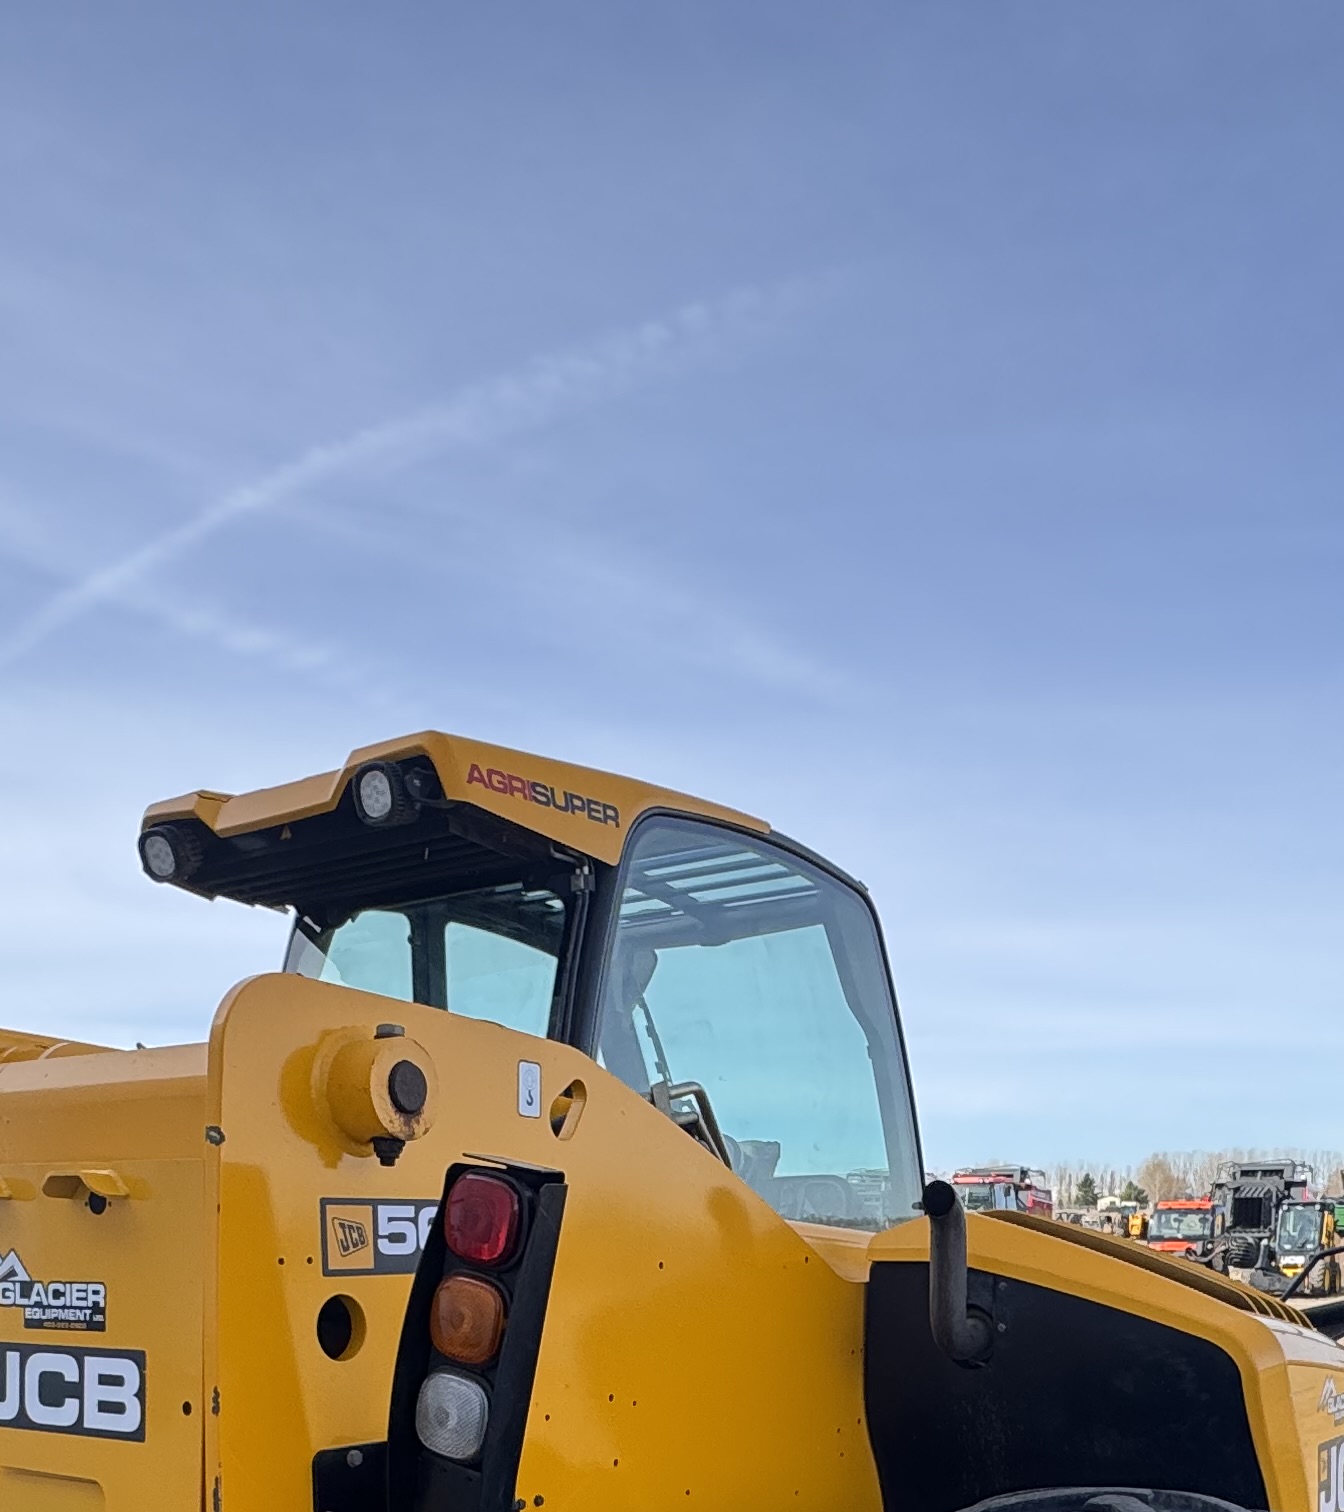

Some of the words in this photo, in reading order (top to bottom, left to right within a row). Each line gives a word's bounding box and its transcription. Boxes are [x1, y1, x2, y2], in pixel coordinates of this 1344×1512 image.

[466, 763, 620, 829] AGRISUPER
[338, 1221, 367, 1253] JCB
[24, 1307, 93, 1321] EQUIPMENT
